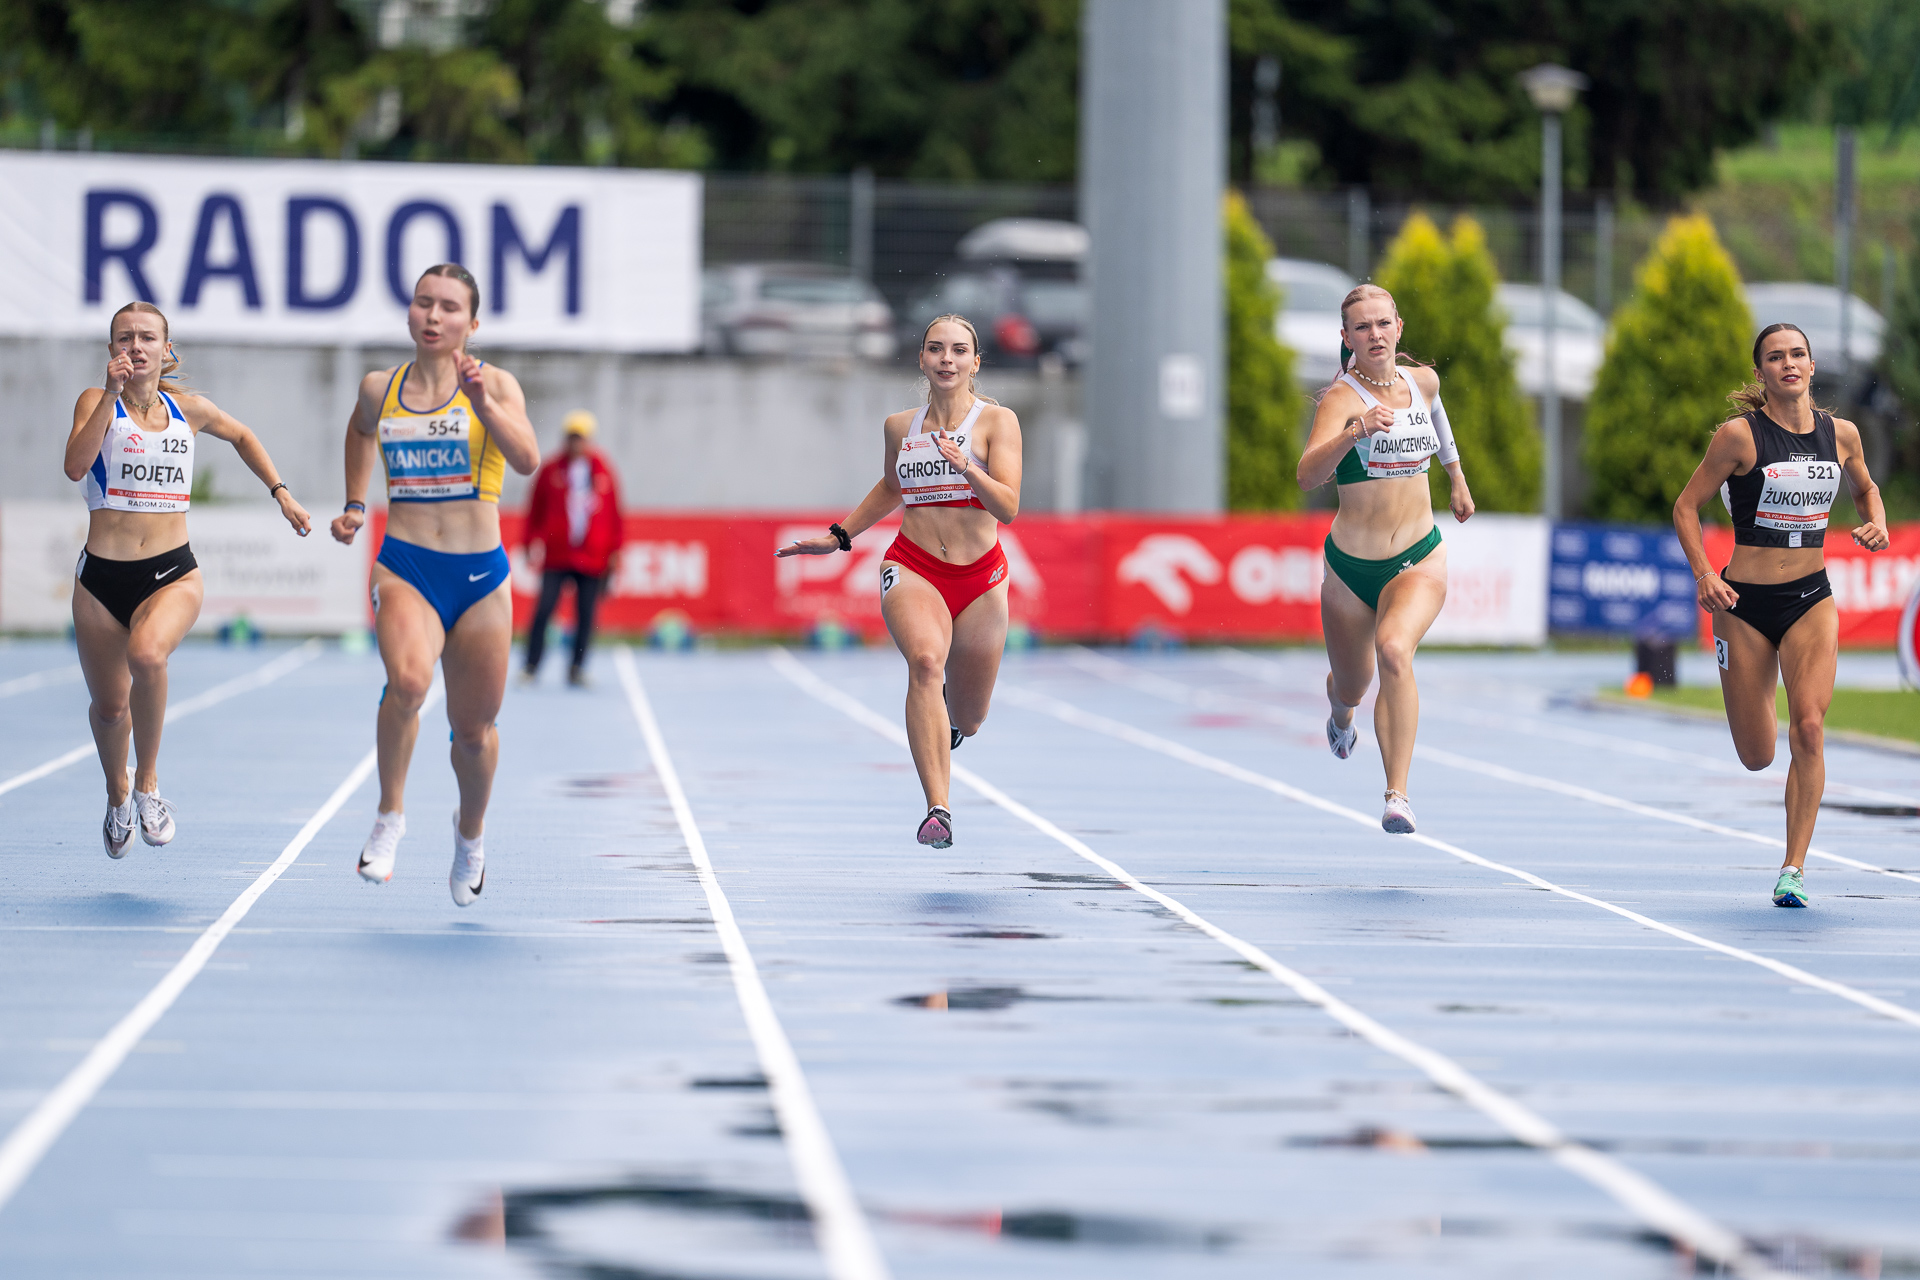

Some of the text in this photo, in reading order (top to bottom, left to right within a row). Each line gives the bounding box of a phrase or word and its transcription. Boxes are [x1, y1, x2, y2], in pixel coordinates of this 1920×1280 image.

[84, 190, 582, 316] RADOM
[427, 420, 461, 436] 554
[161, 438, 188, 454] 125
[1373, 436, 1439, 454] ADAMCZEWSKA
[386, 448, 466, 469] KANICKA
[121, 463, 185, 486] POJĘTA
[899, 460, 963, 479] CHROSTE
[1807, 466, 1835, 480] 521
[128, 499, 157, 507] RADOM
[1763, 487, 1833, 507] ŻUKOWSKA
[1774, 521, 1801, 529] RADOM
[883, 567, 894, 592] 5
[1716, 639, 1725, 666] 3
